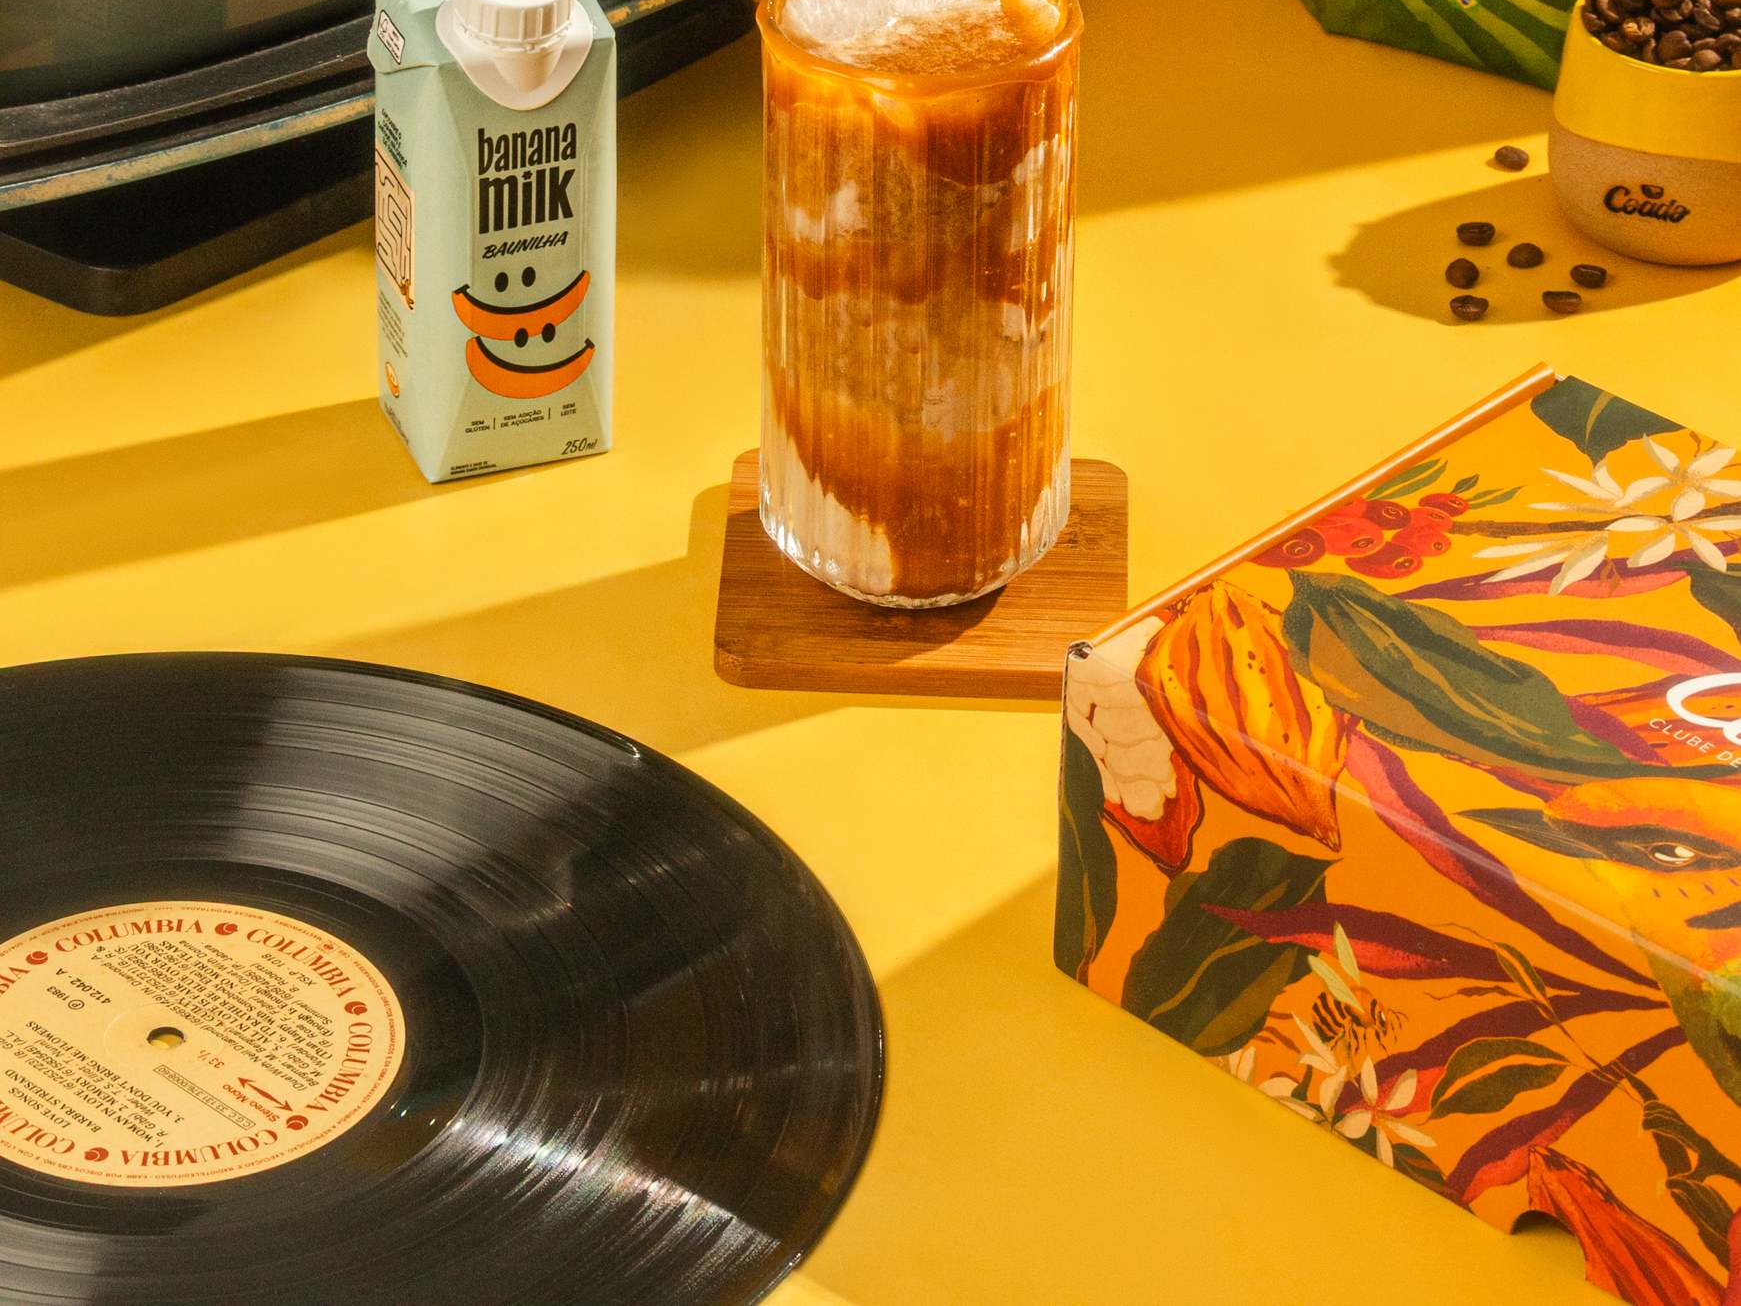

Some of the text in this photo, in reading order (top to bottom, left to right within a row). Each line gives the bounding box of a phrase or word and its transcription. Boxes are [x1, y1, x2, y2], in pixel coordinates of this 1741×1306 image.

[478, 121, 577, 176] banana
[479, 155, 576, 235] milk
[1604, 185, 1692, 223] Coado
[482, 231, 568, 260] BAUNILHA
[562, 402, 577, 410] SEM
[1648, 717, 1716, 753] CLUBE
[55, 919, 203, 952] COLUMBIA
[127, 944, 152, 960] YOU
[158, 940, 193, 962] TEARS
[178, 939, 208, 959] Donna
[150, 957, 180, 977] OVER
[193, 961, 220, 980] MORE
[206, 957, 228, 972] With
[246, 929, 356, 999] COLUMBIA
[249, 962, 289, 986] Roberts)
[55, 967, 111, 1004] 412.042 A
[177, 974, 207, 993] BLUE
[189, 969, 213, 985] Else)
[220, 978, 238, 990] NO
[46, 985, 70, 1001] 1983
[173, 982, 200, 1000] FAIR
[203, 990, 221, 1002] BE
[213, 983, 257, 1012] Somebody
[250, 984, 288, 1010] Enough)
[176, 996, 215, 1022] GUILTY
[197, 998, 211, 1007] IS
[291, 999, 333, 1025] Summer)
[207, 1005, 239, 1024] LOVE
[218, 999, 262, 1027] RATHER
[256, 1010, 276, 1026] With
[238, 1022, 251, 1032] IN
[259, 1025, 277, 1037] I'D
[277, 1023, 306, 1044] Happy
[295, 1024, 318, 1039] Rose
[297, 1013, 334, 1037] (Enough
[25, 1021, 74, 1052] FLOWERS
[250, 1029, 272, 1044] ALL
[70, 1049, 89, 1062] ME
[240, 1049, 262, 1063] Neil
[305, 1040, 333, 1060] (Than
[86, 1059, 121, 1082] BRING
[208, 1057, 225, 1069] 33
[260, 1060, 283, 1076] With
[306, 1022, 373, 1112] COLUMBIA
[281, 1061, 319, 1087] Bergman
[4, 1069, 102, 1133] BARBRA STREISAND
[72, 1076, 116, 1106] MEMORY
[73, 1088, 104, 1109] LOVE
[117, 1080, 152, 1102] DON'T
[7, 1087, 71, 1129] LOVE SONGS
[100, 1106, 117, 1118] IN
[117, 1103, 129, 1112] 2.
[126, 1097, 155, 1117] Weber
[148, 1101, 173, 1117] YOU
[113, 1115, 153, 1142] WOMAN
[173, 1114, 185, 1124] 3.
[121, 1129, 278, 1167] COLUMBIA
